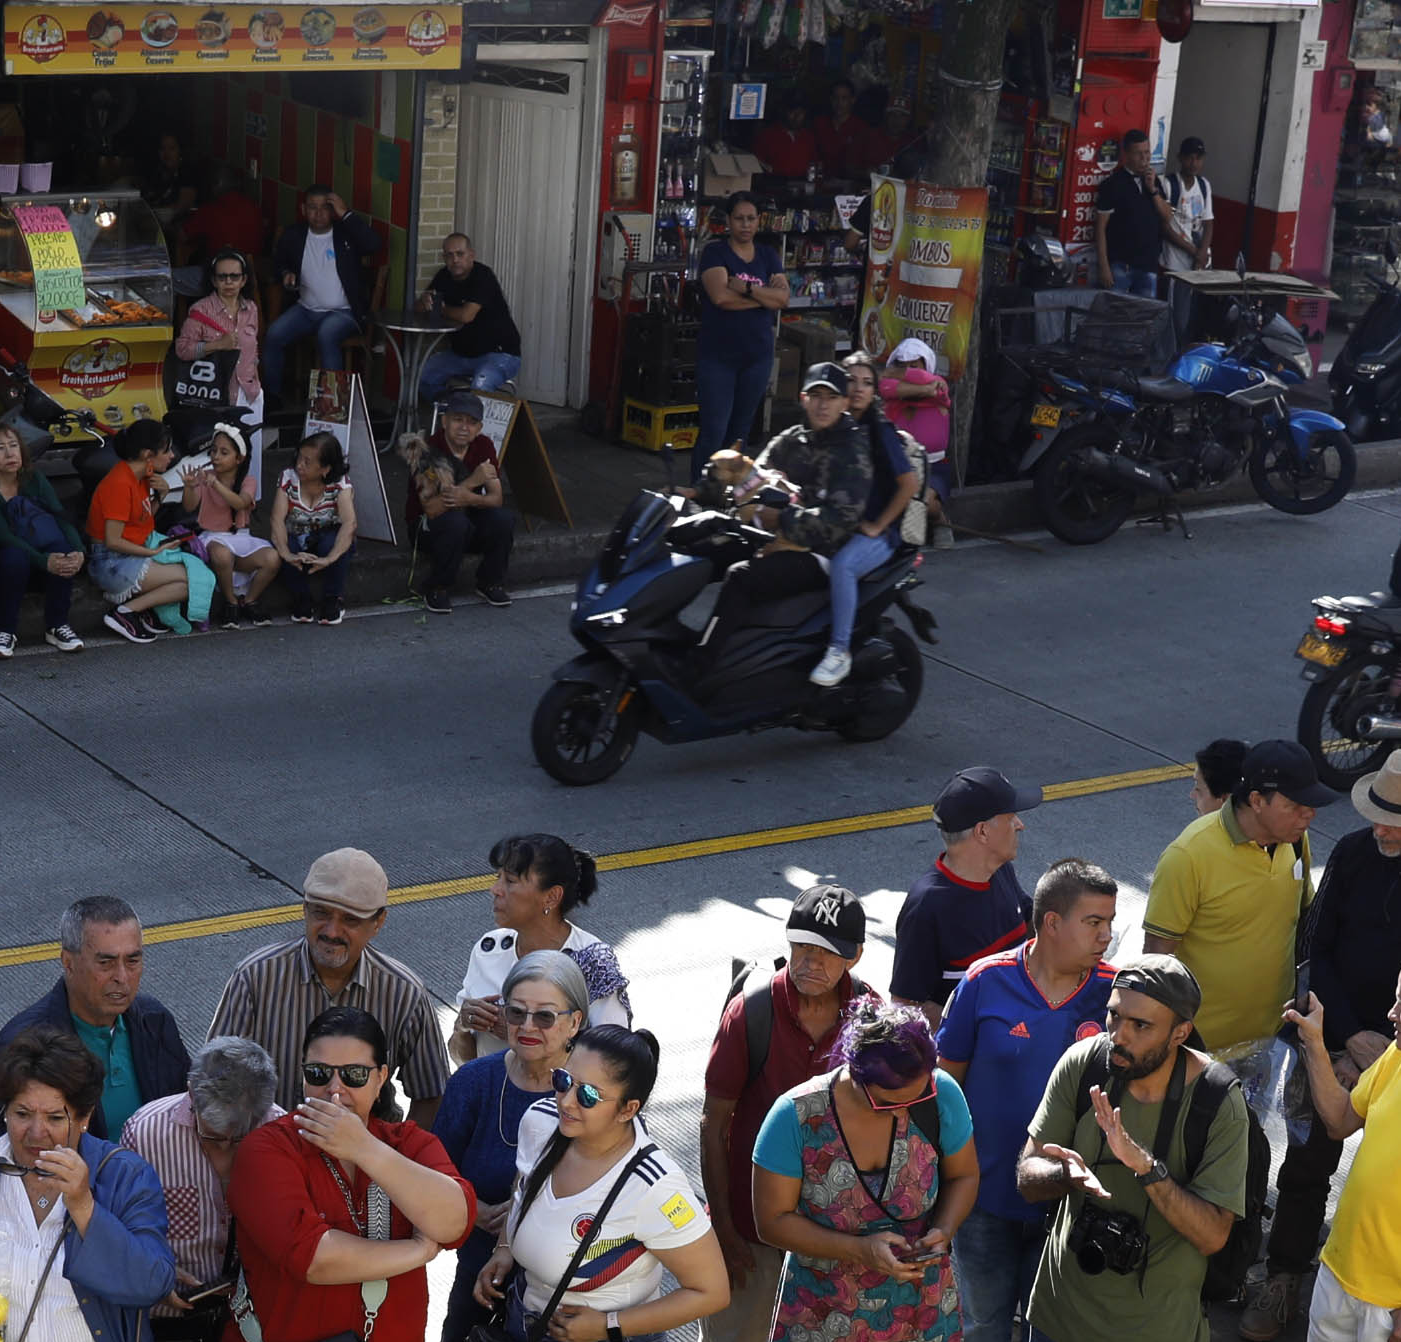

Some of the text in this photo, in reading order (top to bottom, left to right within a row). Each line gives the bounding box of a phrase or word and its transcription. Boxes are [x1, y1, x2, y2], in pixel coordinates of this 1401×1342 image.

[61, 371, 127, 385] BrostyRestaurante
[176, 382, 221, 400] BONA
[813, 896, 841, 927] NY
[667, 1205, 682, 1219] FIFA
